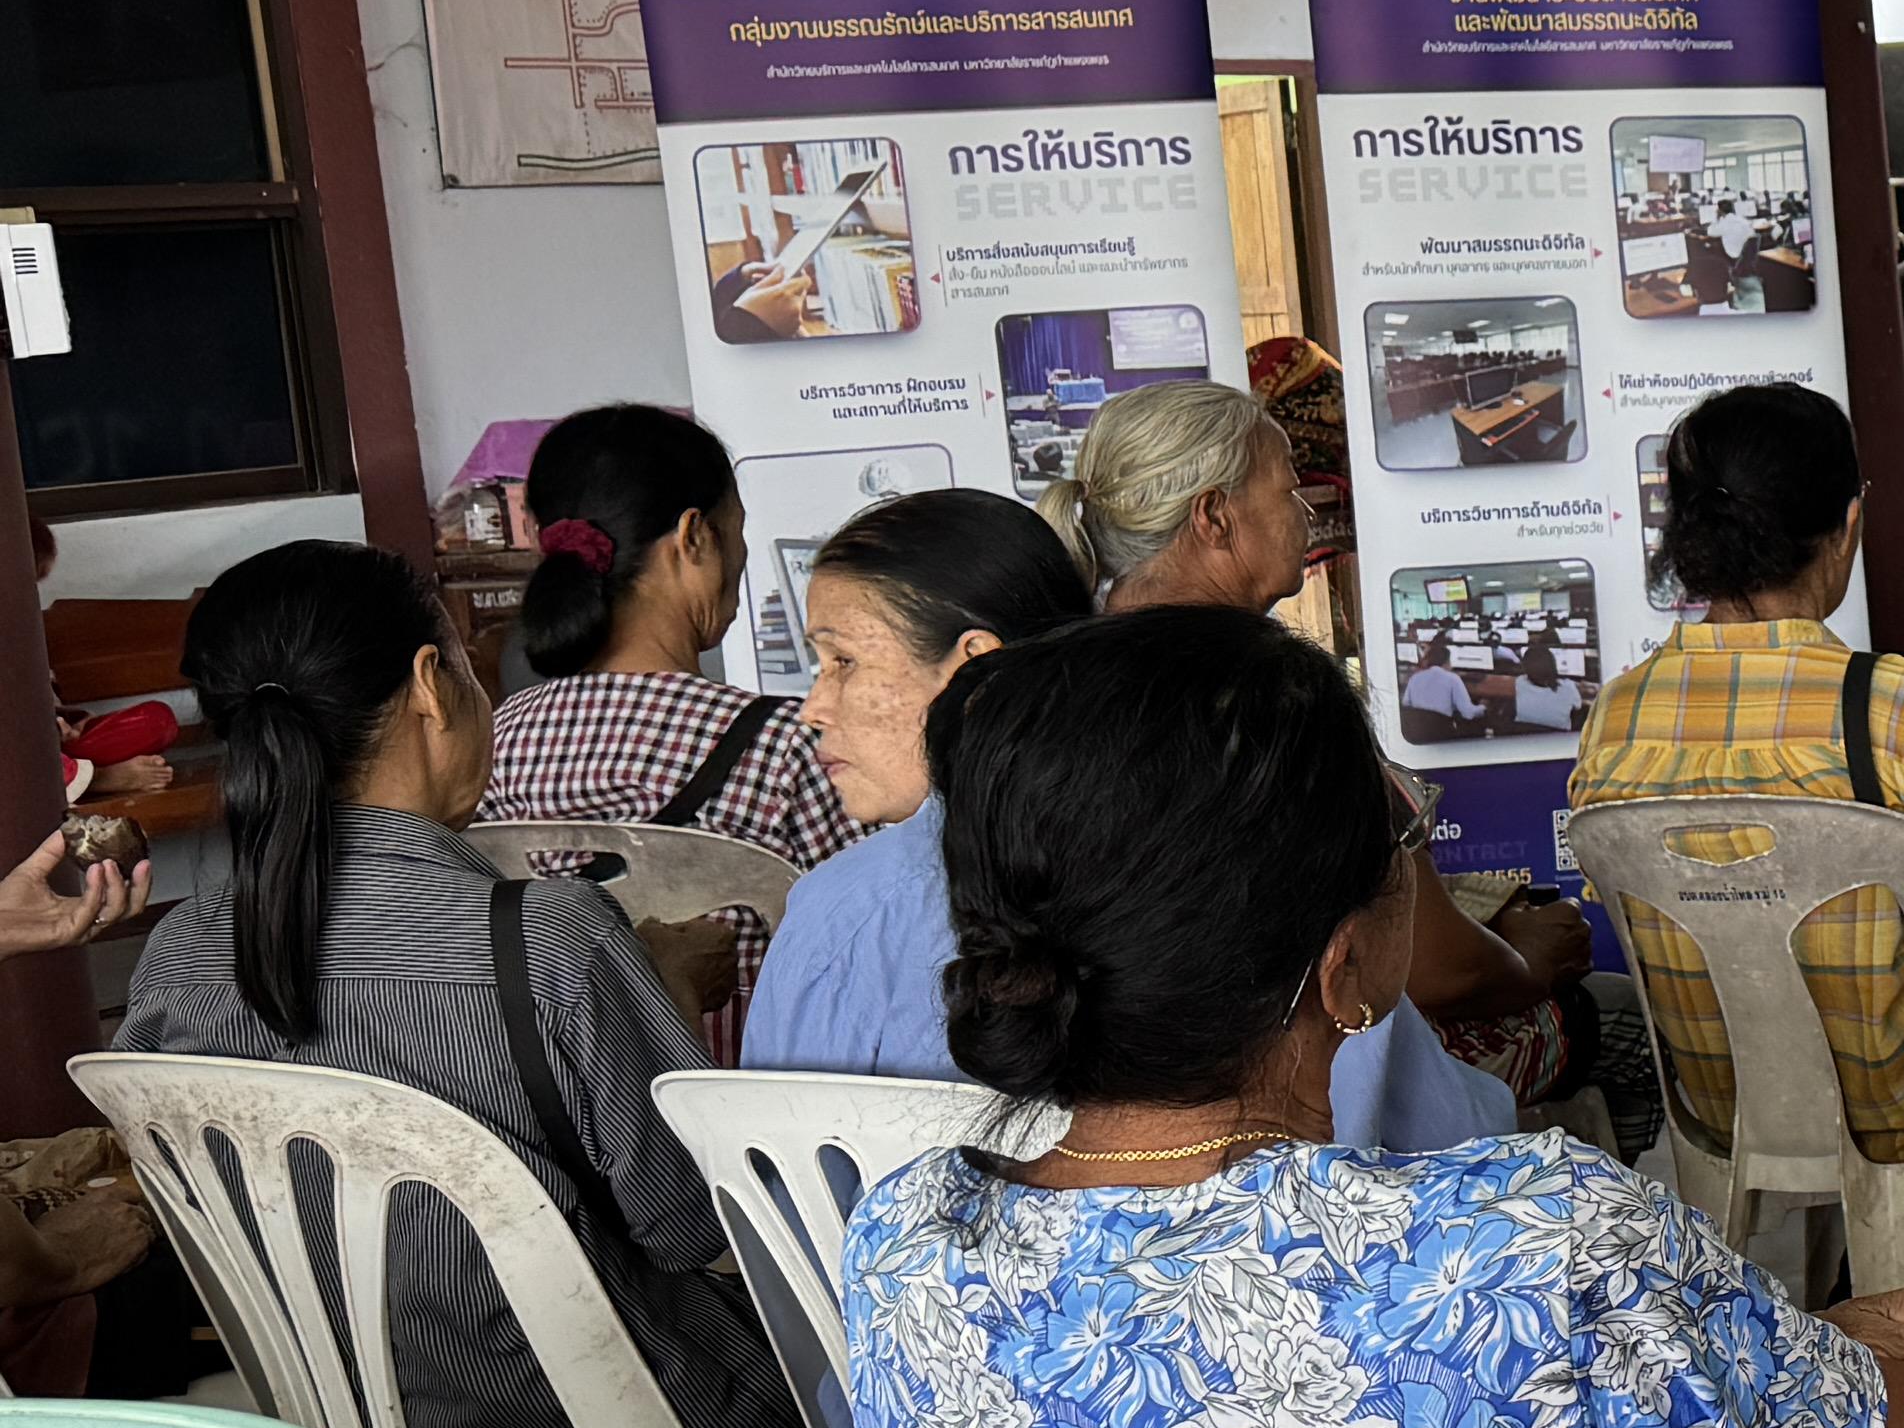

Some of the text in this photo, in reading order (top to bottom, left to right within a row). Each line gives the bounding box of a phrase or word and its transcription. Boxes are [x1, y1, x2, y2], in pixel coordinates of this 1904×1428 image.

[730, 7, 1133, 48] กลุ่มงานบรรณรักษ์และบริการสารสนเทศ
[1455, 8, 1698, 32] และพัฒนาสมรรถนะดิจิทัล
[948, 129, 1192, 175] การให้บริการ
[1353, 115, 1583, 157] การให้บริการ
[955, 174, 1198, 221] SERVICE
[1358, 163, 1588, 204] SERVICE
[1421, 233, 1586, 254] พัฒนาสมรรถนะดิจิทัล
